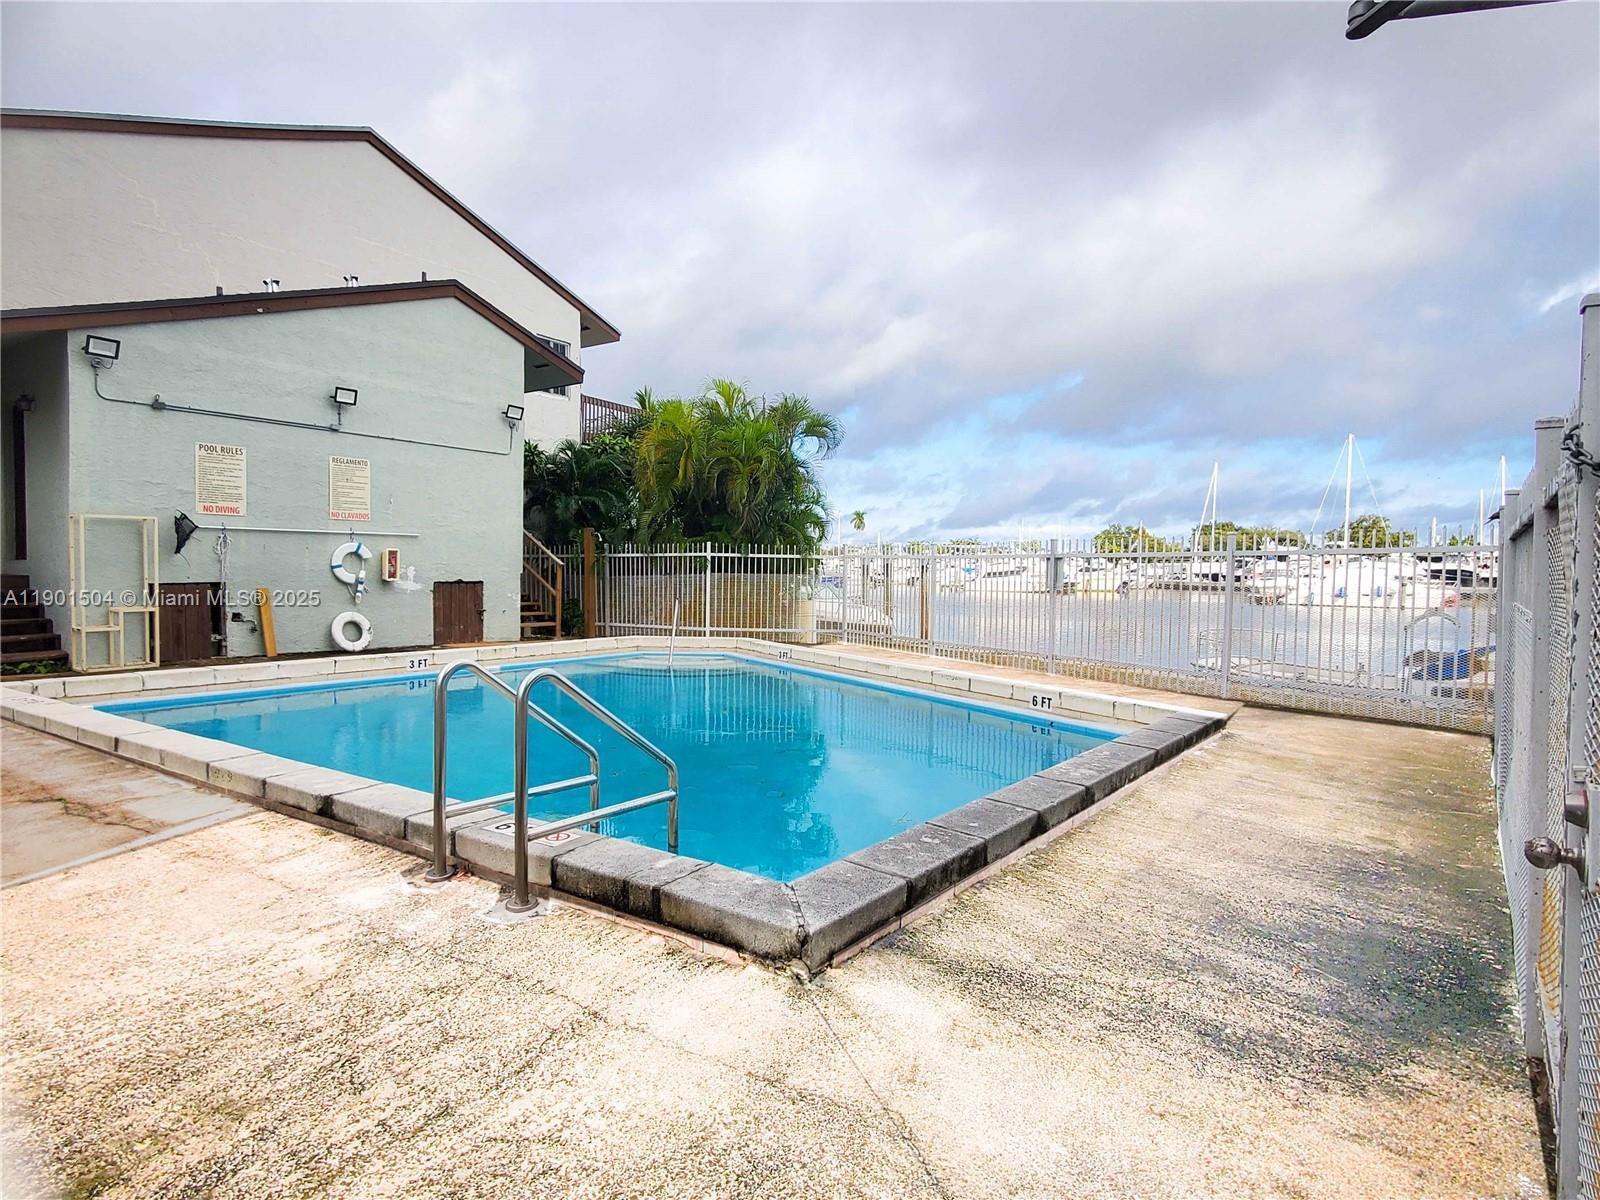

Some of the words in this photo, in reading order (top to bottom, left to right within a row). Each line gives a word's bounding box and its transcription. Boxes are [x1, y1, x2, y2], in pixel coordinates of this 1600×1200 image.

[198, 444, 218, 453] POOL
[221, 446, 244, 456] RULES
[332, 457, 368, 466] REGLAMENTO
[215, 506, 240, 514] DIVING
[341, 512, 369, 520] CLAVADOS
[410, 660, 414, 668] 3
[418, 658, 428, 668] FT
[1032, 696, 1038, 706] 6
[1041, 696, 1052, 709] FT
